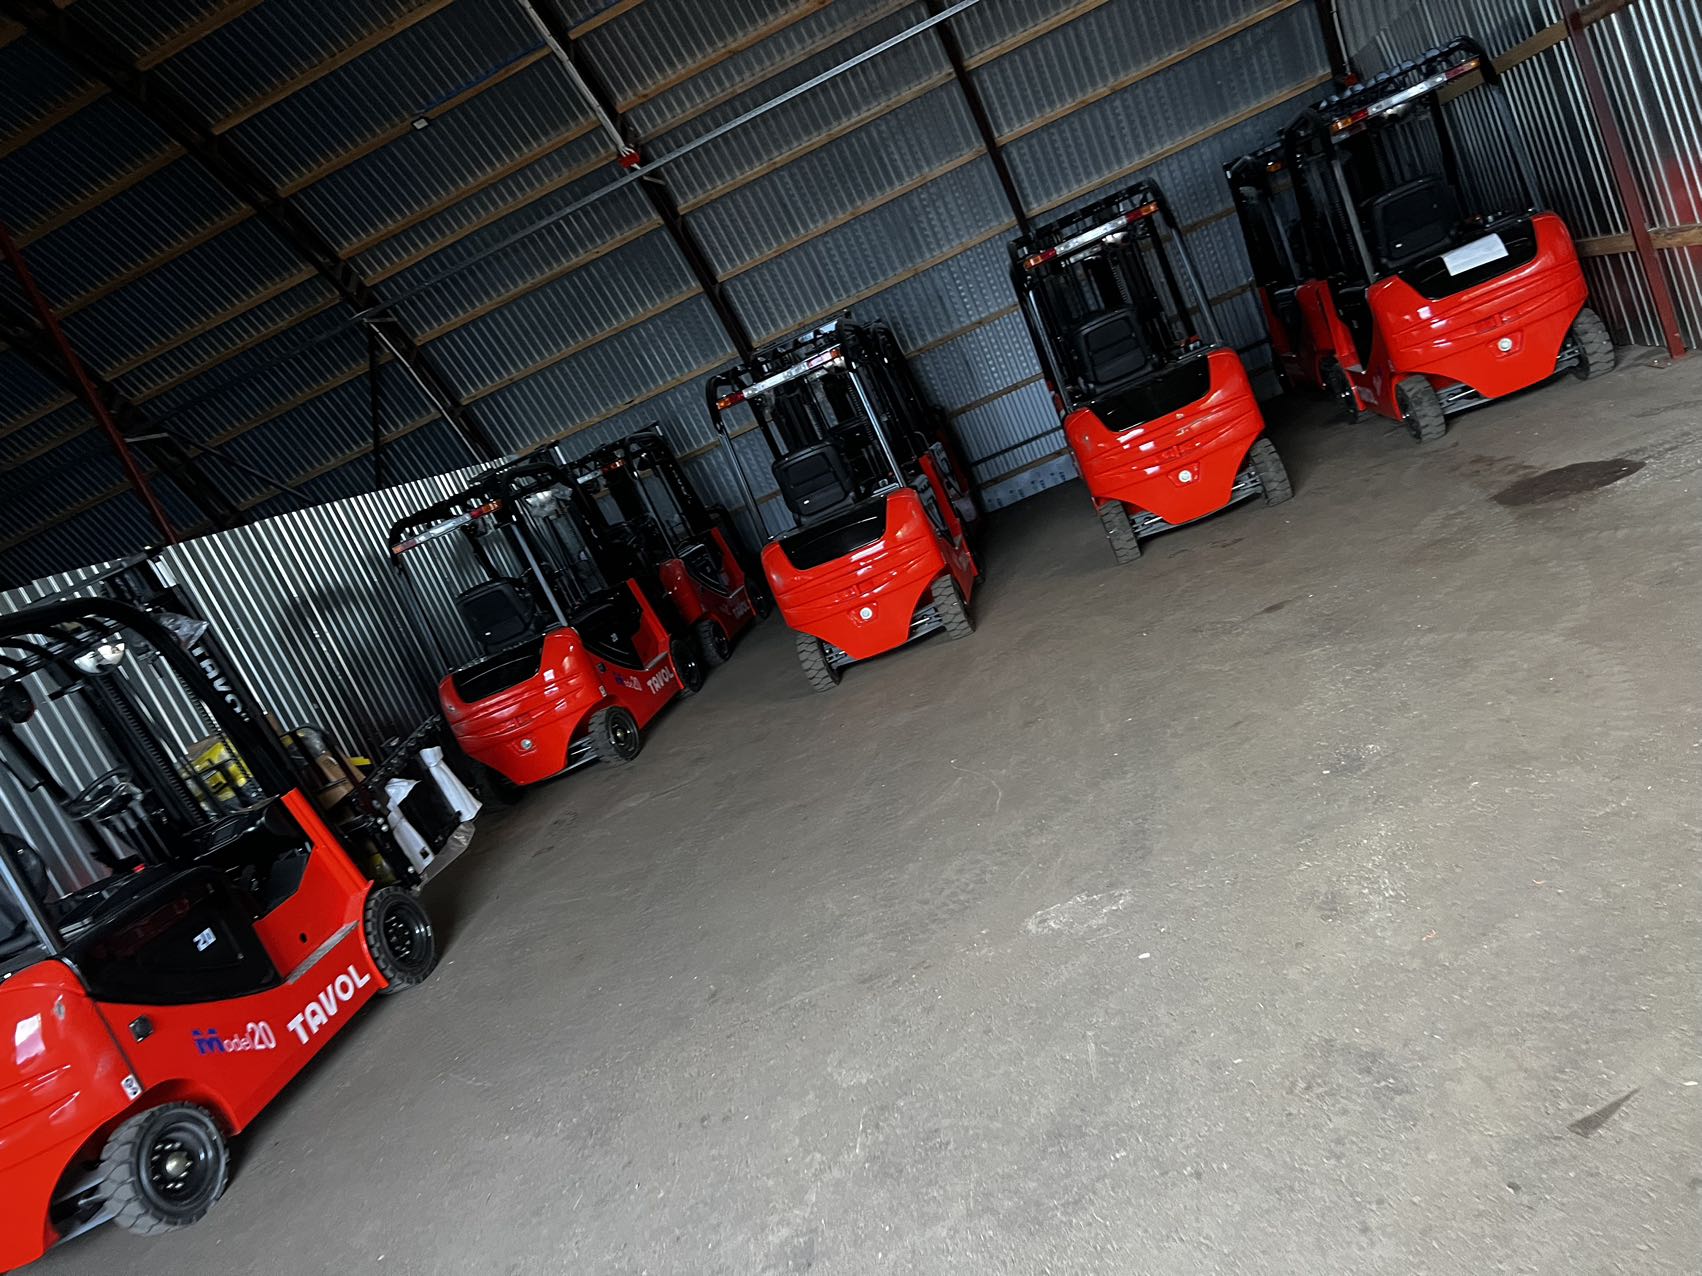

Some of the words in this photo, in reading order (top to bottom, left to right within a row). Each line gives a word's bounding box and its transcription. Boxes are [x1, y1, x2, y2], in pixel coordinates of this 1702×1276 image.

[191, 645, 250, 722] TAVO
[646, 666, 674, 695] TAVOL
[286, 964, 371, 1045] TAVOL
